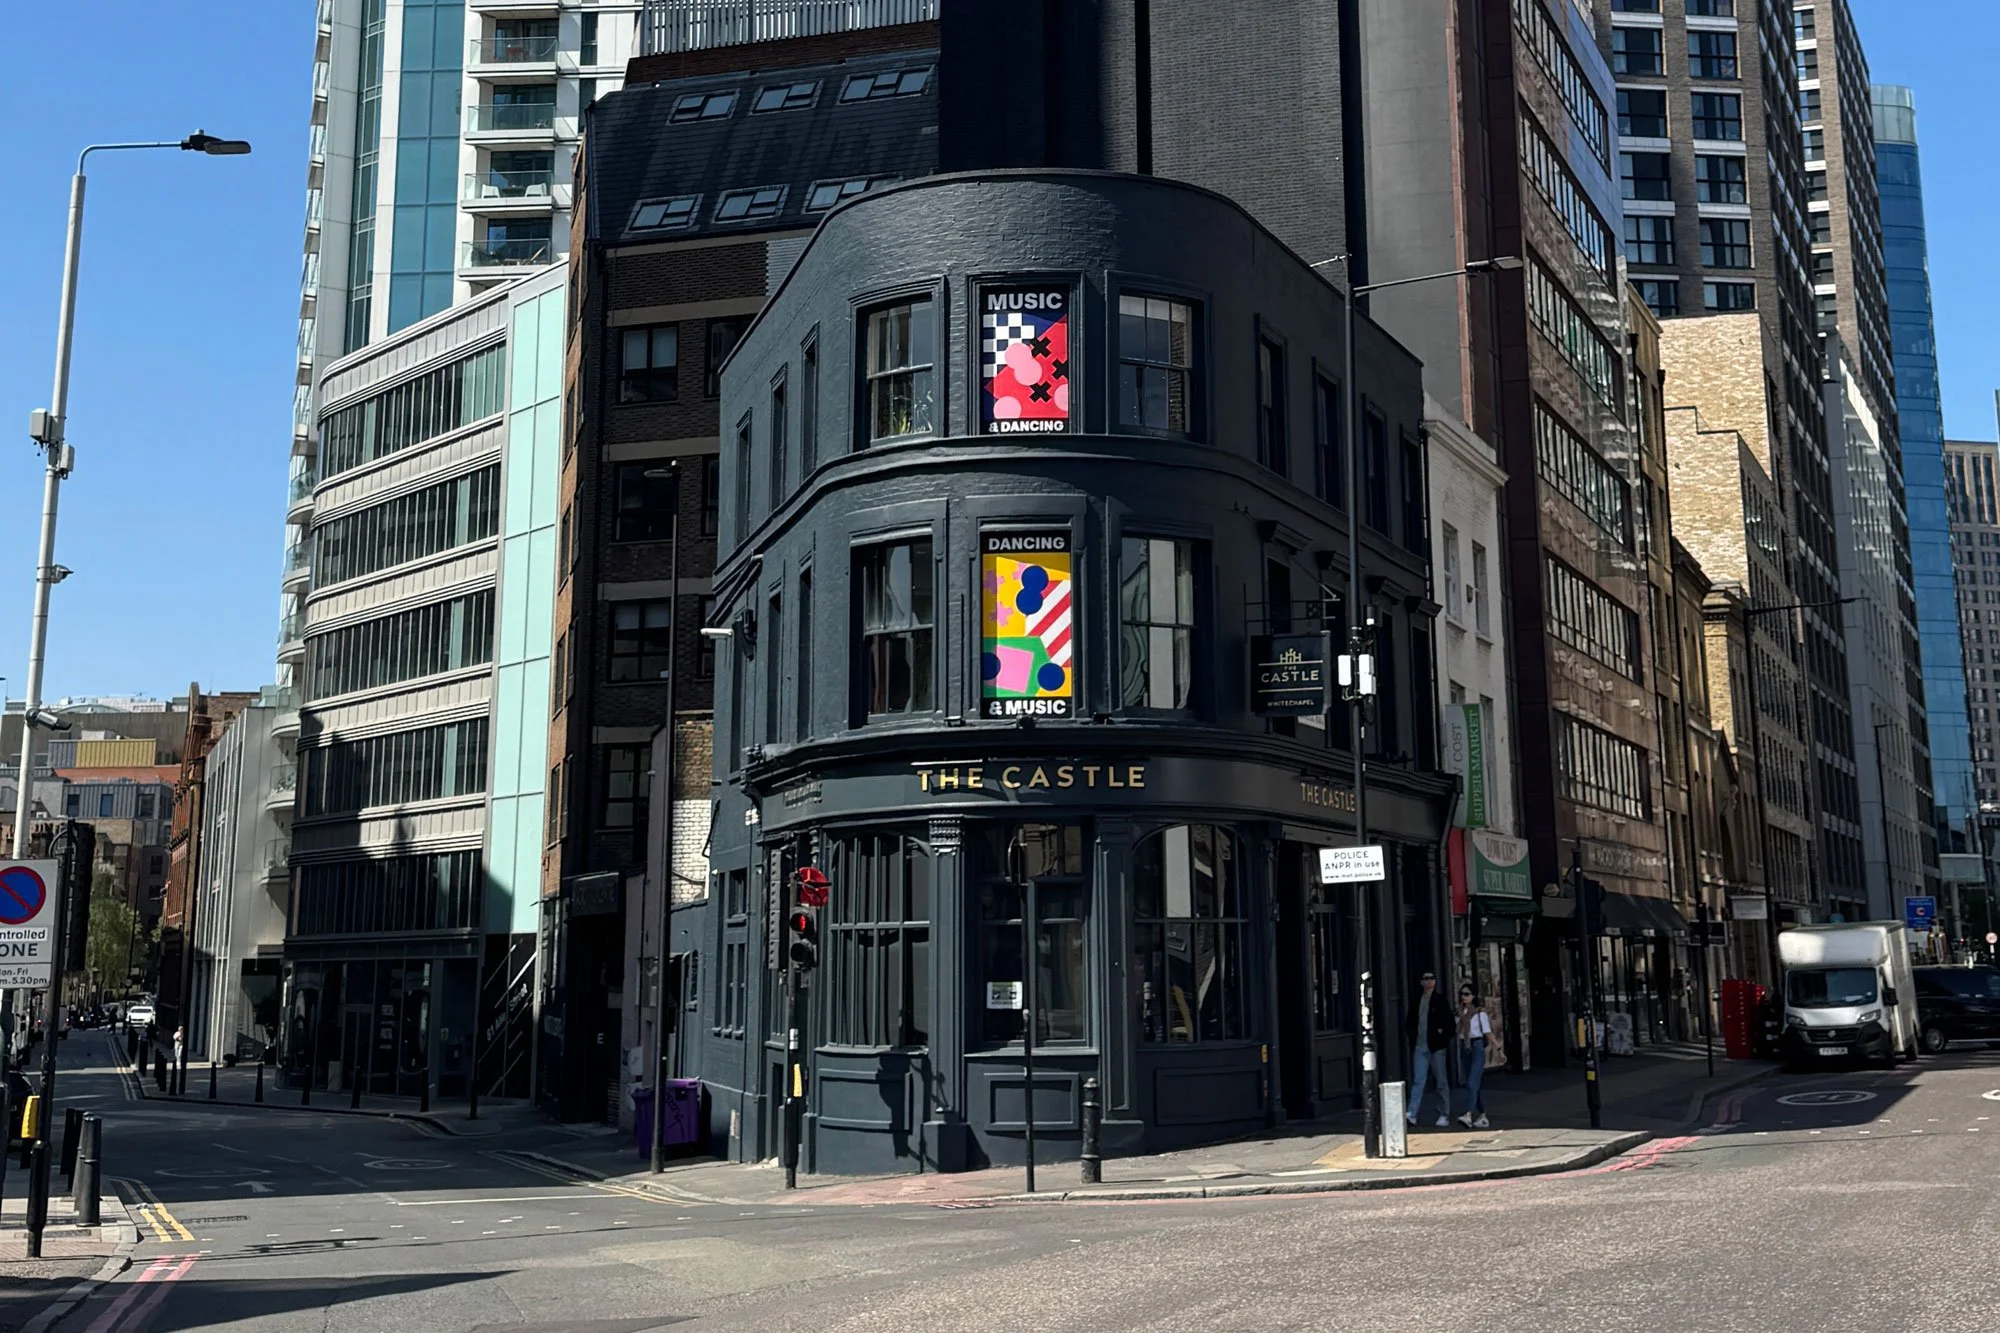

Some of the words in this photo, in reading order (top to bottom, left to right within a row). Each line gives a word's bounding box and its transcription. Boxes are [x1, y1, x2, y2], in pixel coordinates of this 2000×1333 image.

[988, 293, 1062, 310] MUSIC
[989, 422, 999, 432] &
[1001, 420, 1064, 432] DANCING
[988, 537, 1065, 550] DANCING
[1261, 670, 1319, 683] CASTLE
[989, 702, 1002, 715] &
[1005, 700, 1066, 715] MUSIC
[1452, 723, 1463, 762] COST
[1469, 710, 1481, 771] MARKET
[916, 767, 984, 792] THE
[1002, 766, 1145, 789] CASTLE
[1300, 782, 1319, 804] THE
[1322, 787, 1356, 812] CASTLE
[1473, 774, 1483, 821] SUPER
[1334, 851, 1369, 859] POLICE
[1325, 861, 1351, 870] ANPR
